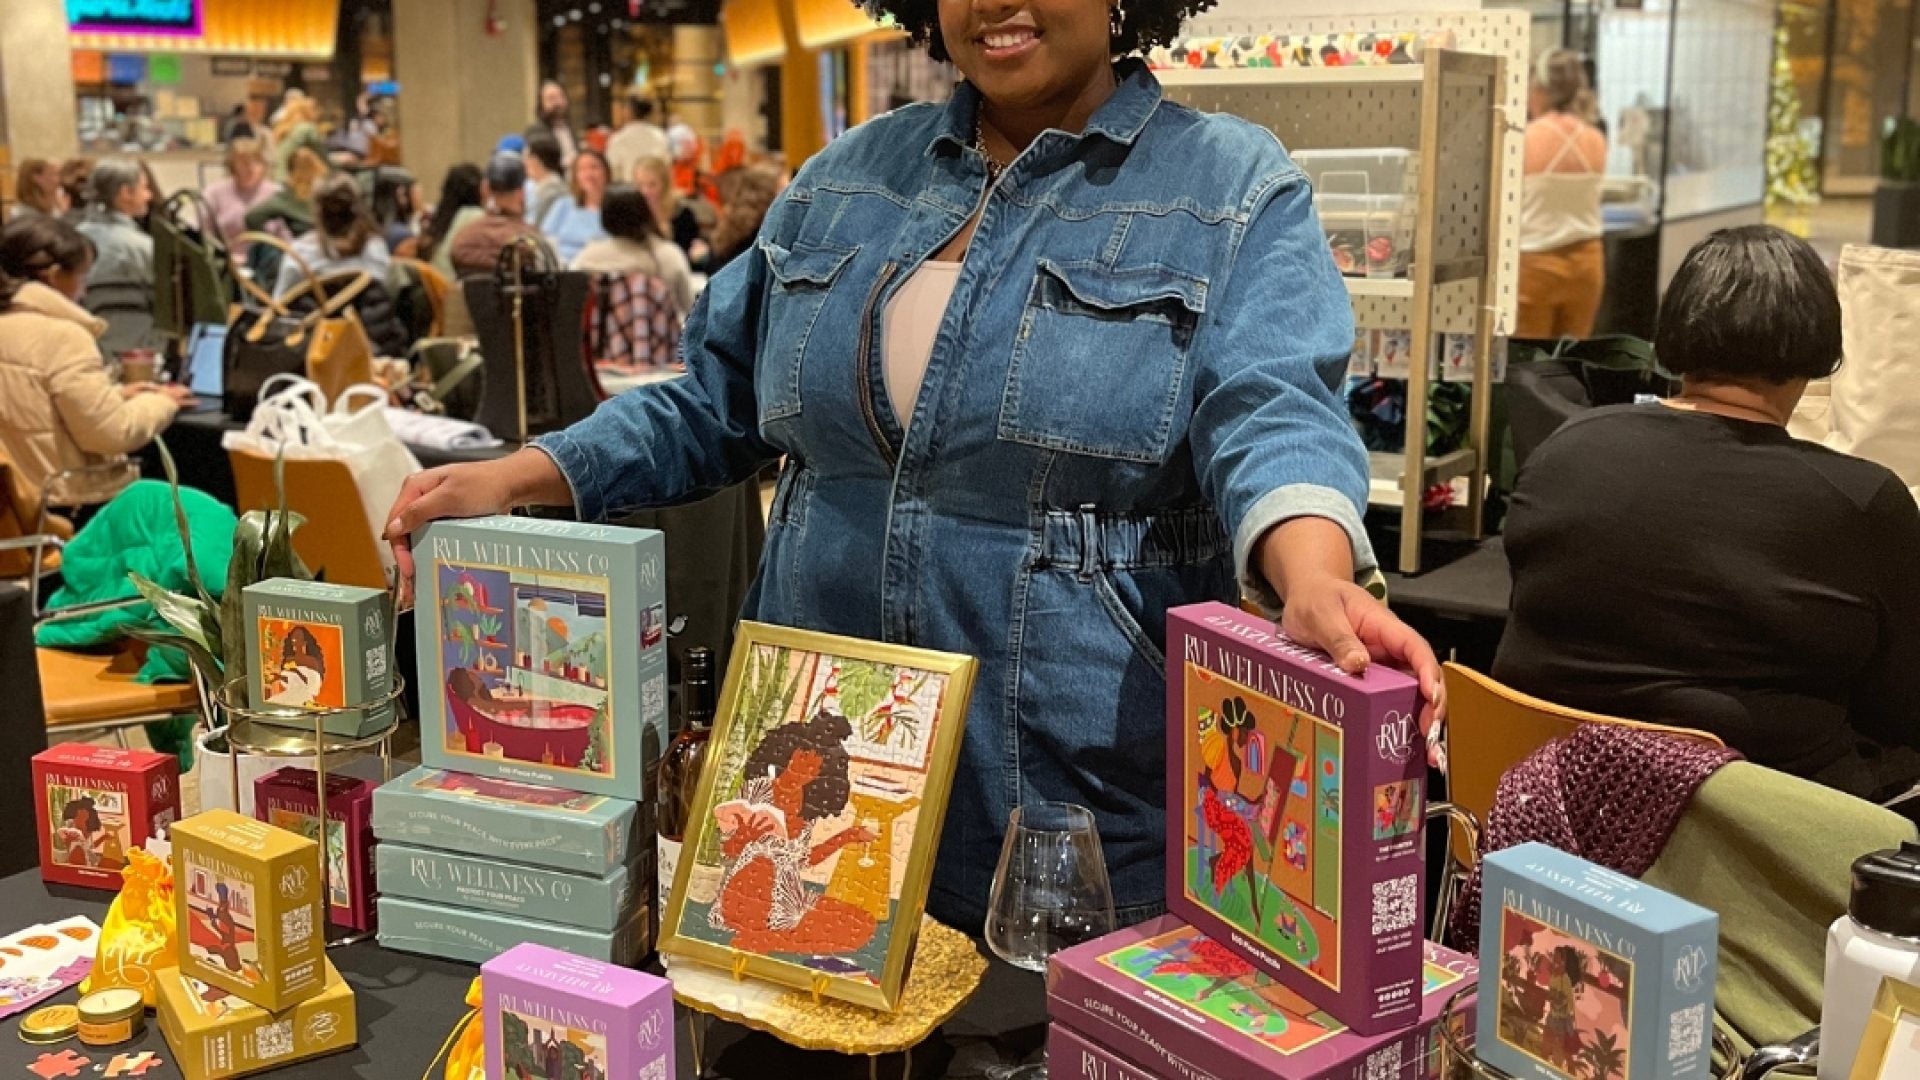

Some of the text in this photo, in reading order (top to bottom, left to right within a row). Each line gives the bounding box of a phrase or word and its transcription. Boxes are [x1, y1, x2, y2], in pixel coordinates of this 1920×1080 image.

[432, 536, 467, 572] RVL
[472, 541, 580, 572] WELLNESS
[277, 606, 328, 624] WELLNESS
[1184, 633, 1214, 674] RVL
[1219, 647, 1316, 713] WELLNESS
[63, 775, 115, 791] WELLNESS
[408, 811, 437, 820] SECURE
[410, 857, 442, 889] RVL
[447, 862, 545, 898] WELLNESS
[1531, 898, 1613, 951] WELLNESS
[523, 998, 589, 1029] WELLNESS
[1084, 997, 1114, 1016] SECURE
[1116, 1013, 1139, 1032] YOUR
[1140, 1028, 1167, 1057] PEACE
[1167, 1054, 1189, 1077] WITH
